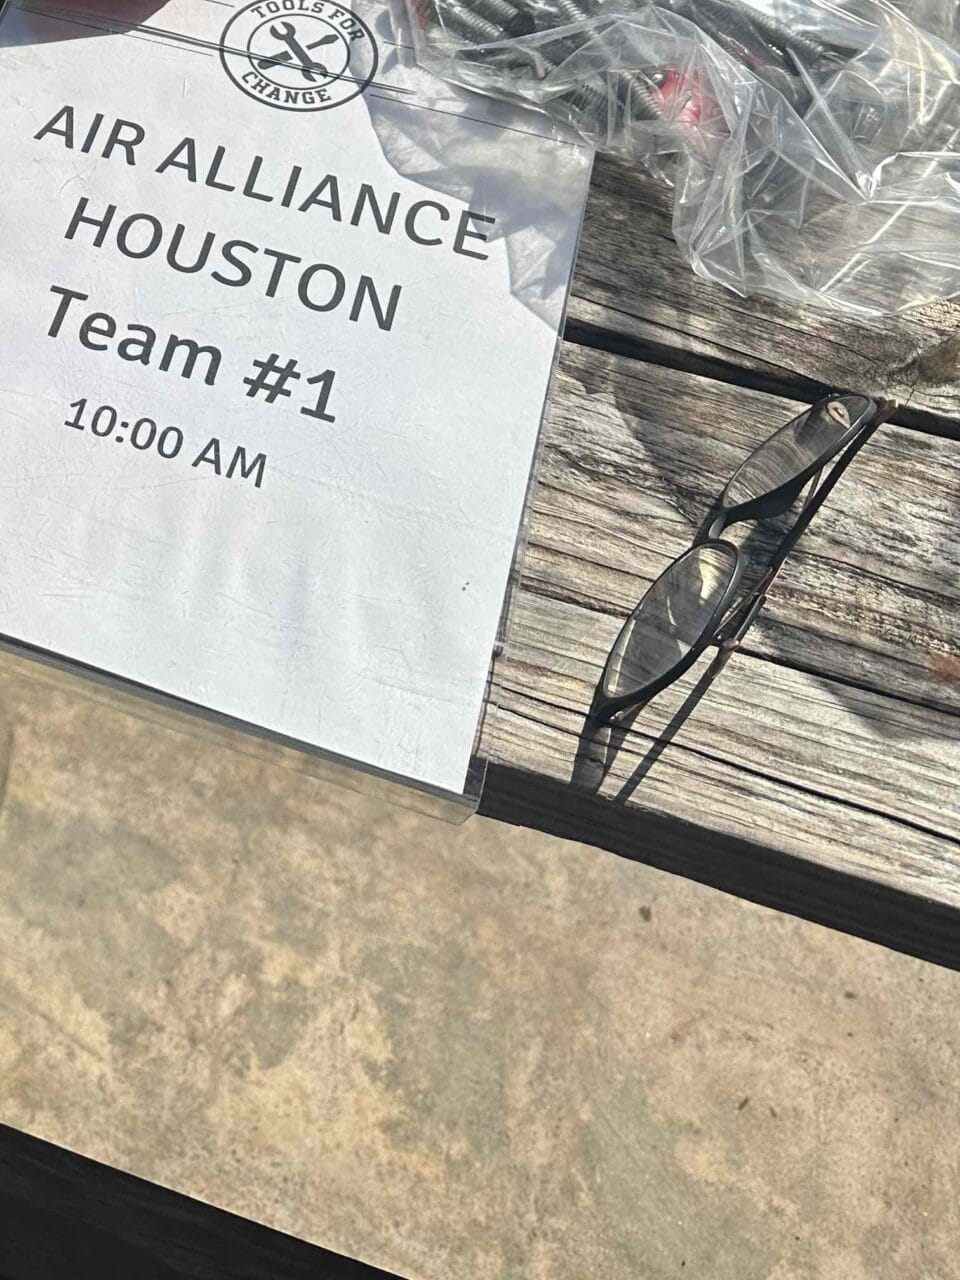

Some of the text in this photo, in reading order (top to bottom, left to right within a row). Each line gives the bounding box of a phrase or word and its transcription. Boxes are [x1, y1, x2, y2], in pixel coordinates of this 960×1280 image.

[328, 8, 365, 42] FOR
[241, 70, 332, 105] CHANGE
[33, 105, 496, 261] AIR ALLIANCE
[64, 196, 402, 332] HOUSTON
[47, 284, 337, 423] Team #1
[64, 397, 268, 488] 10:00 AM
